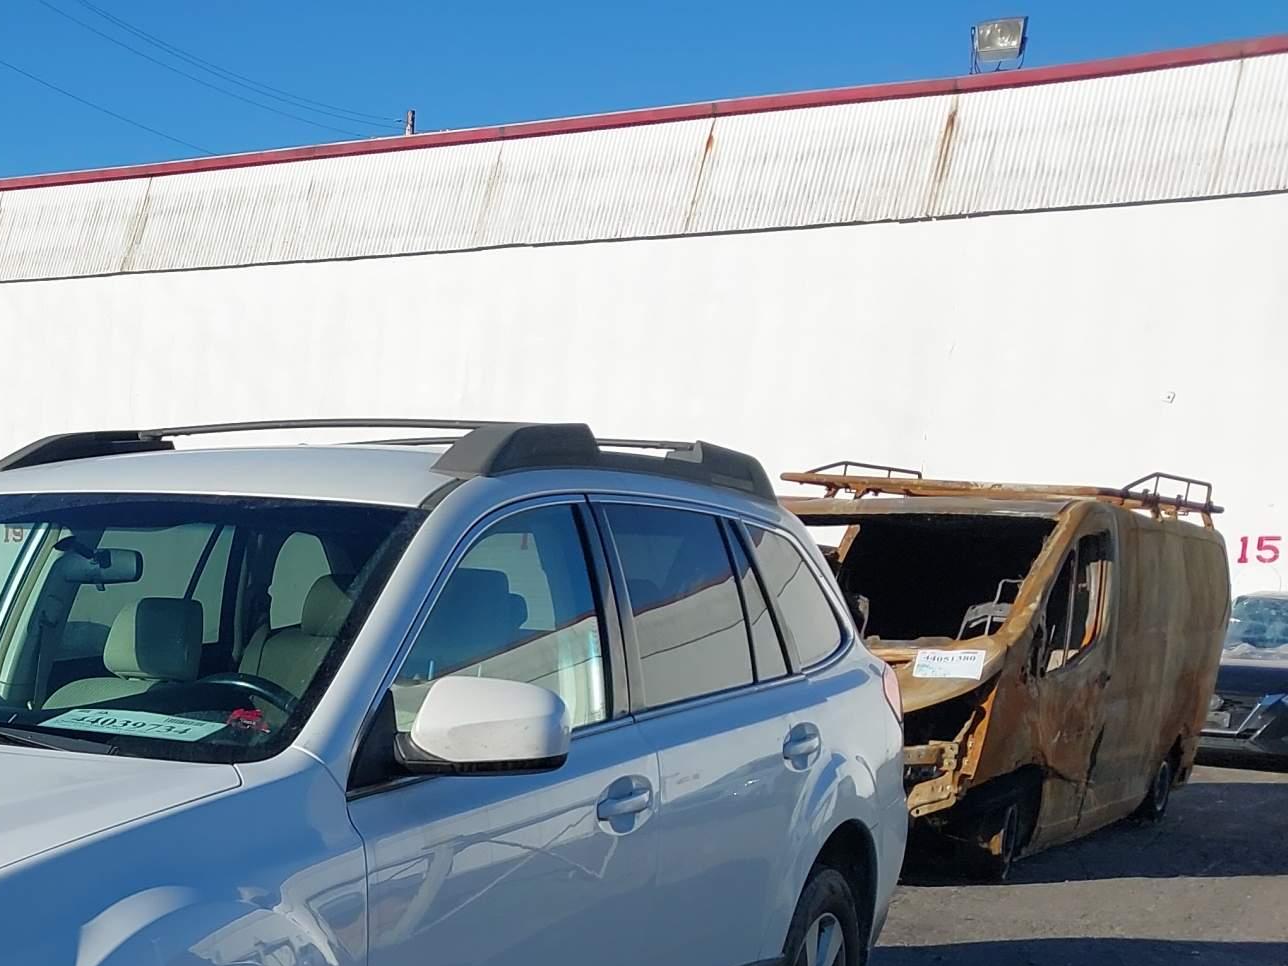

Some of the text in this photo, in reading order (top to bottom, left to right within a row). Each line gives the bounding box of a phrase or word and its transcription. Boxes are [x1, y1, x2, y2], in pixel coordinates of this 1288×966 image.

[4, 523, 24, 543] 19
[1237, 536, 1282, 563] 15
[71, 716, 192, 734] 44039734
